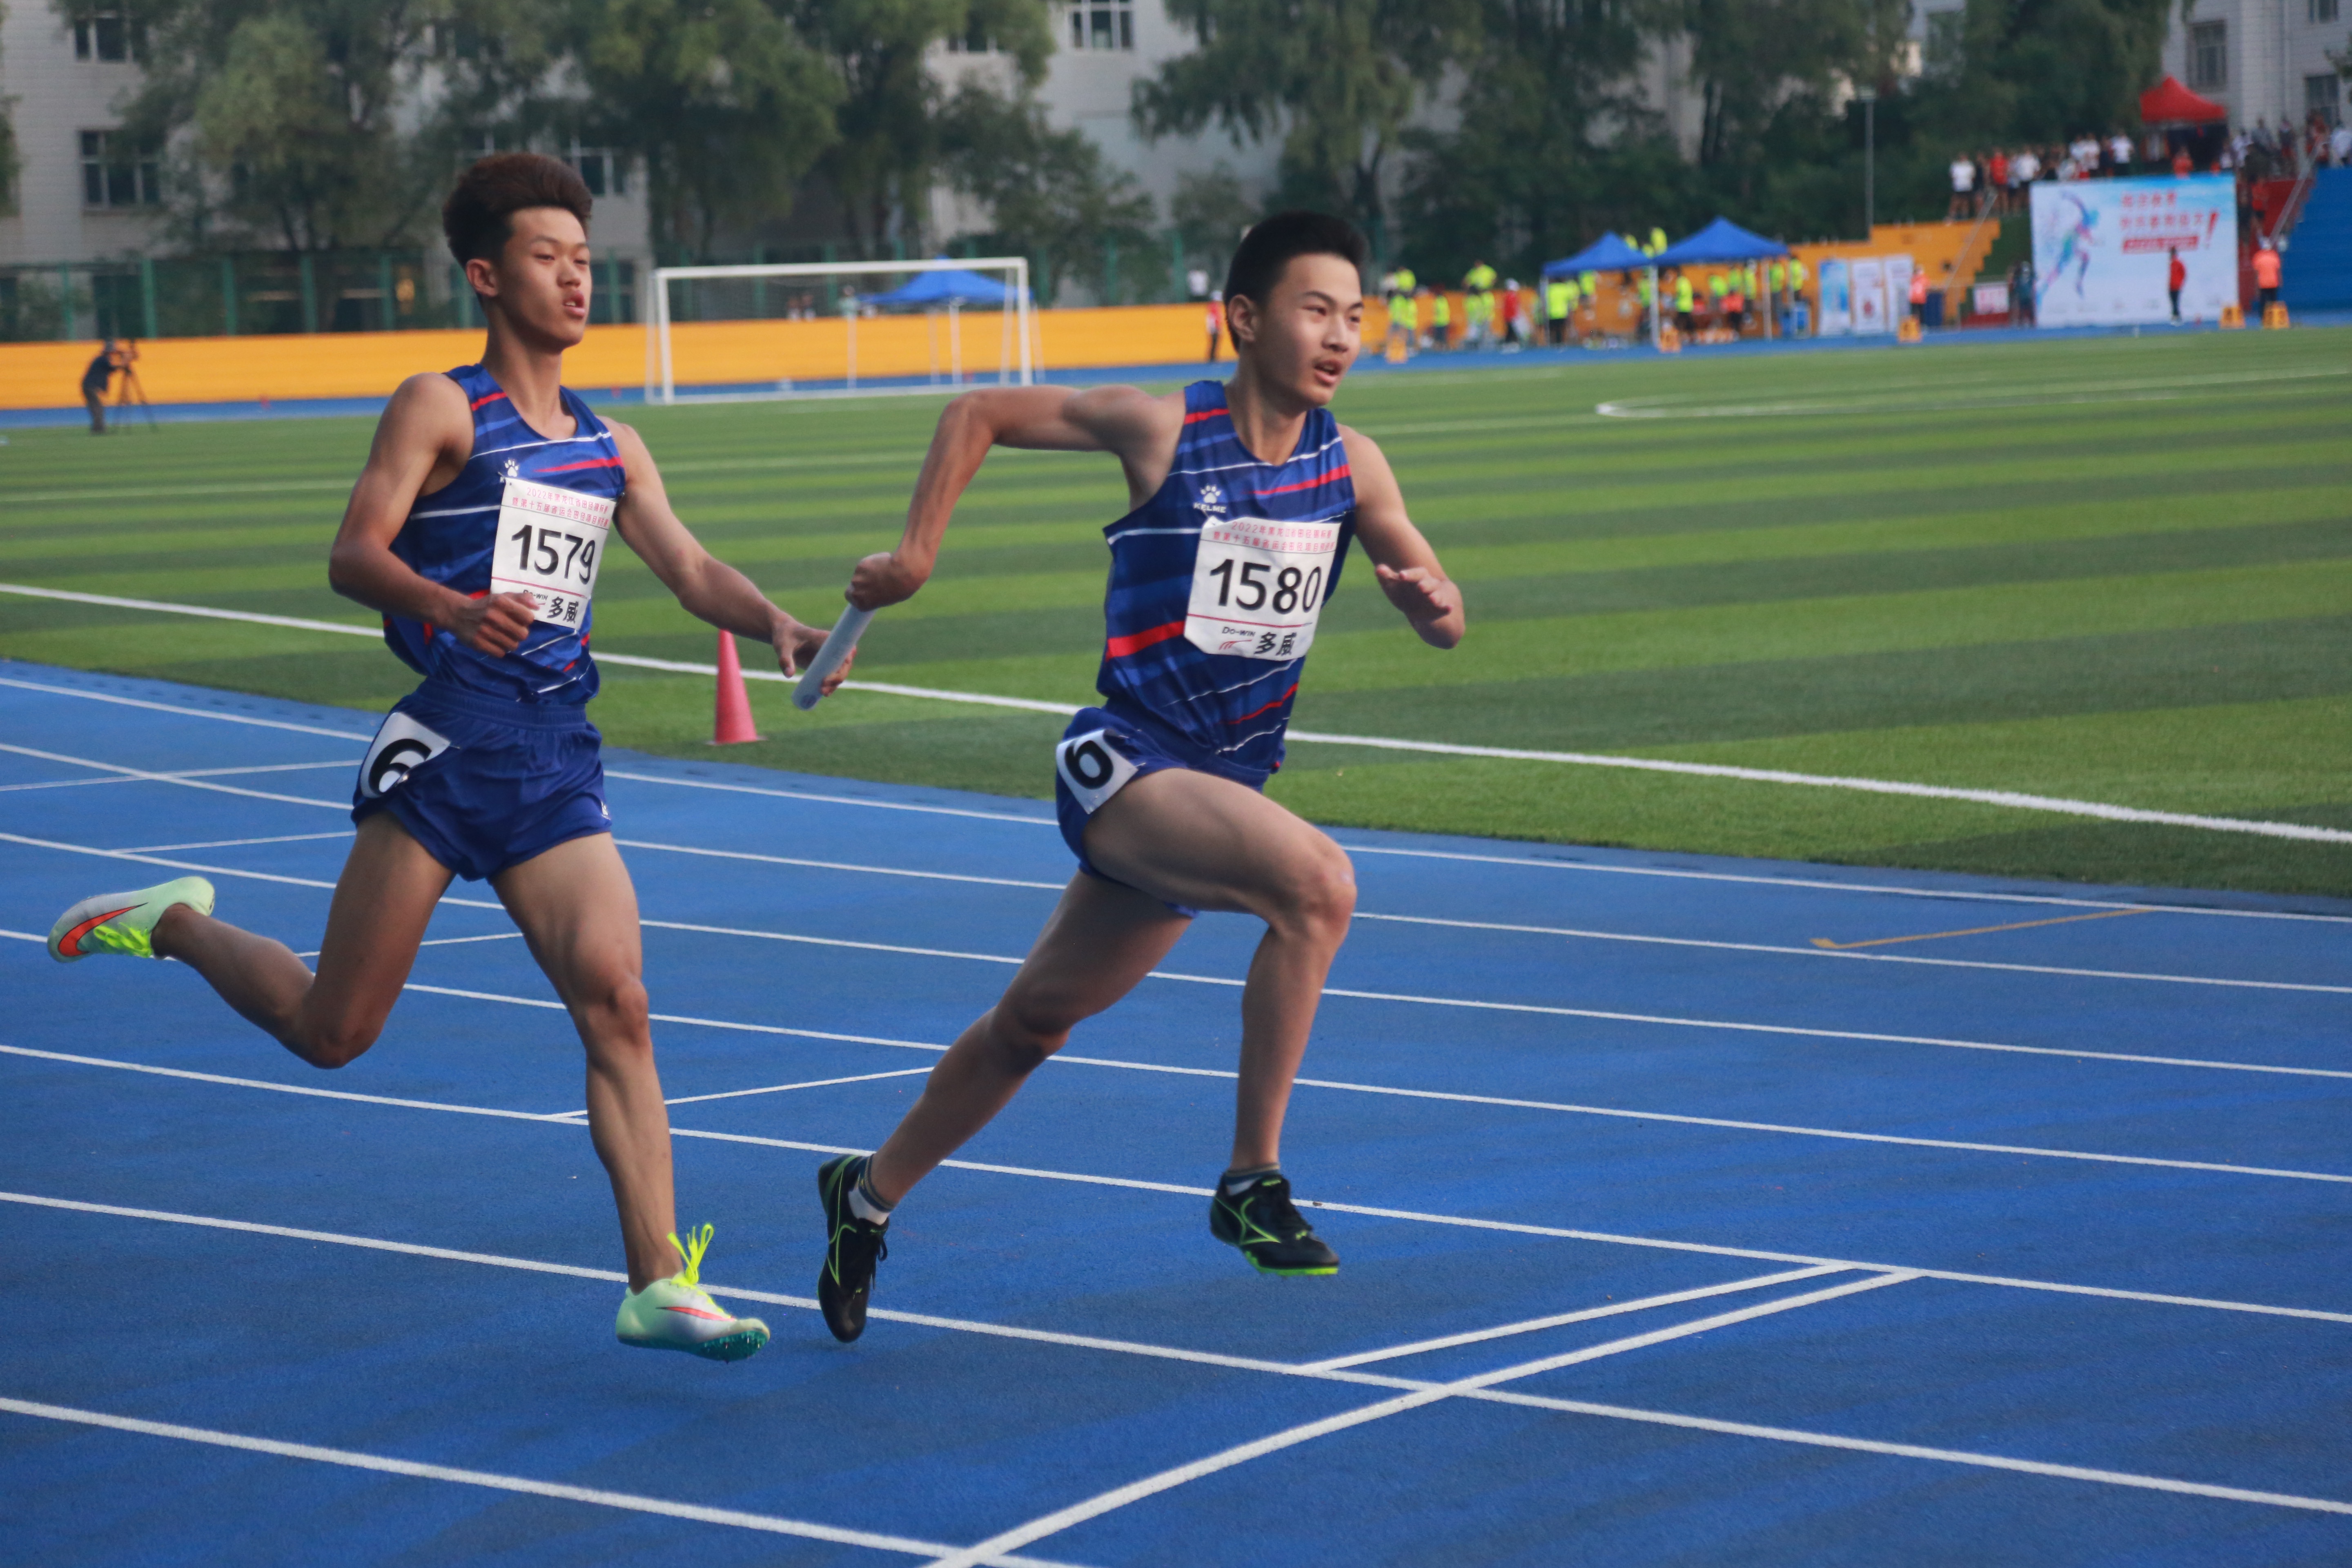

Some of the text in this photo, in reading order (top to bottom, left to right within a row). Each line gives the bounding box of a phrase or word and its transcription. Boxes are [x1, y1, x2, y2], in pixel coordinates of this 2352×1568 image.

[1194, 502, 1226, 513] KELME
[511, 524, 596, 585] 1579
[1209, 559, 1321, 615] 1580
[547, 596, 579, 624] 多威
[1254, 632, 1296, 656] 多威
[369, 738, 432, 795] 6
